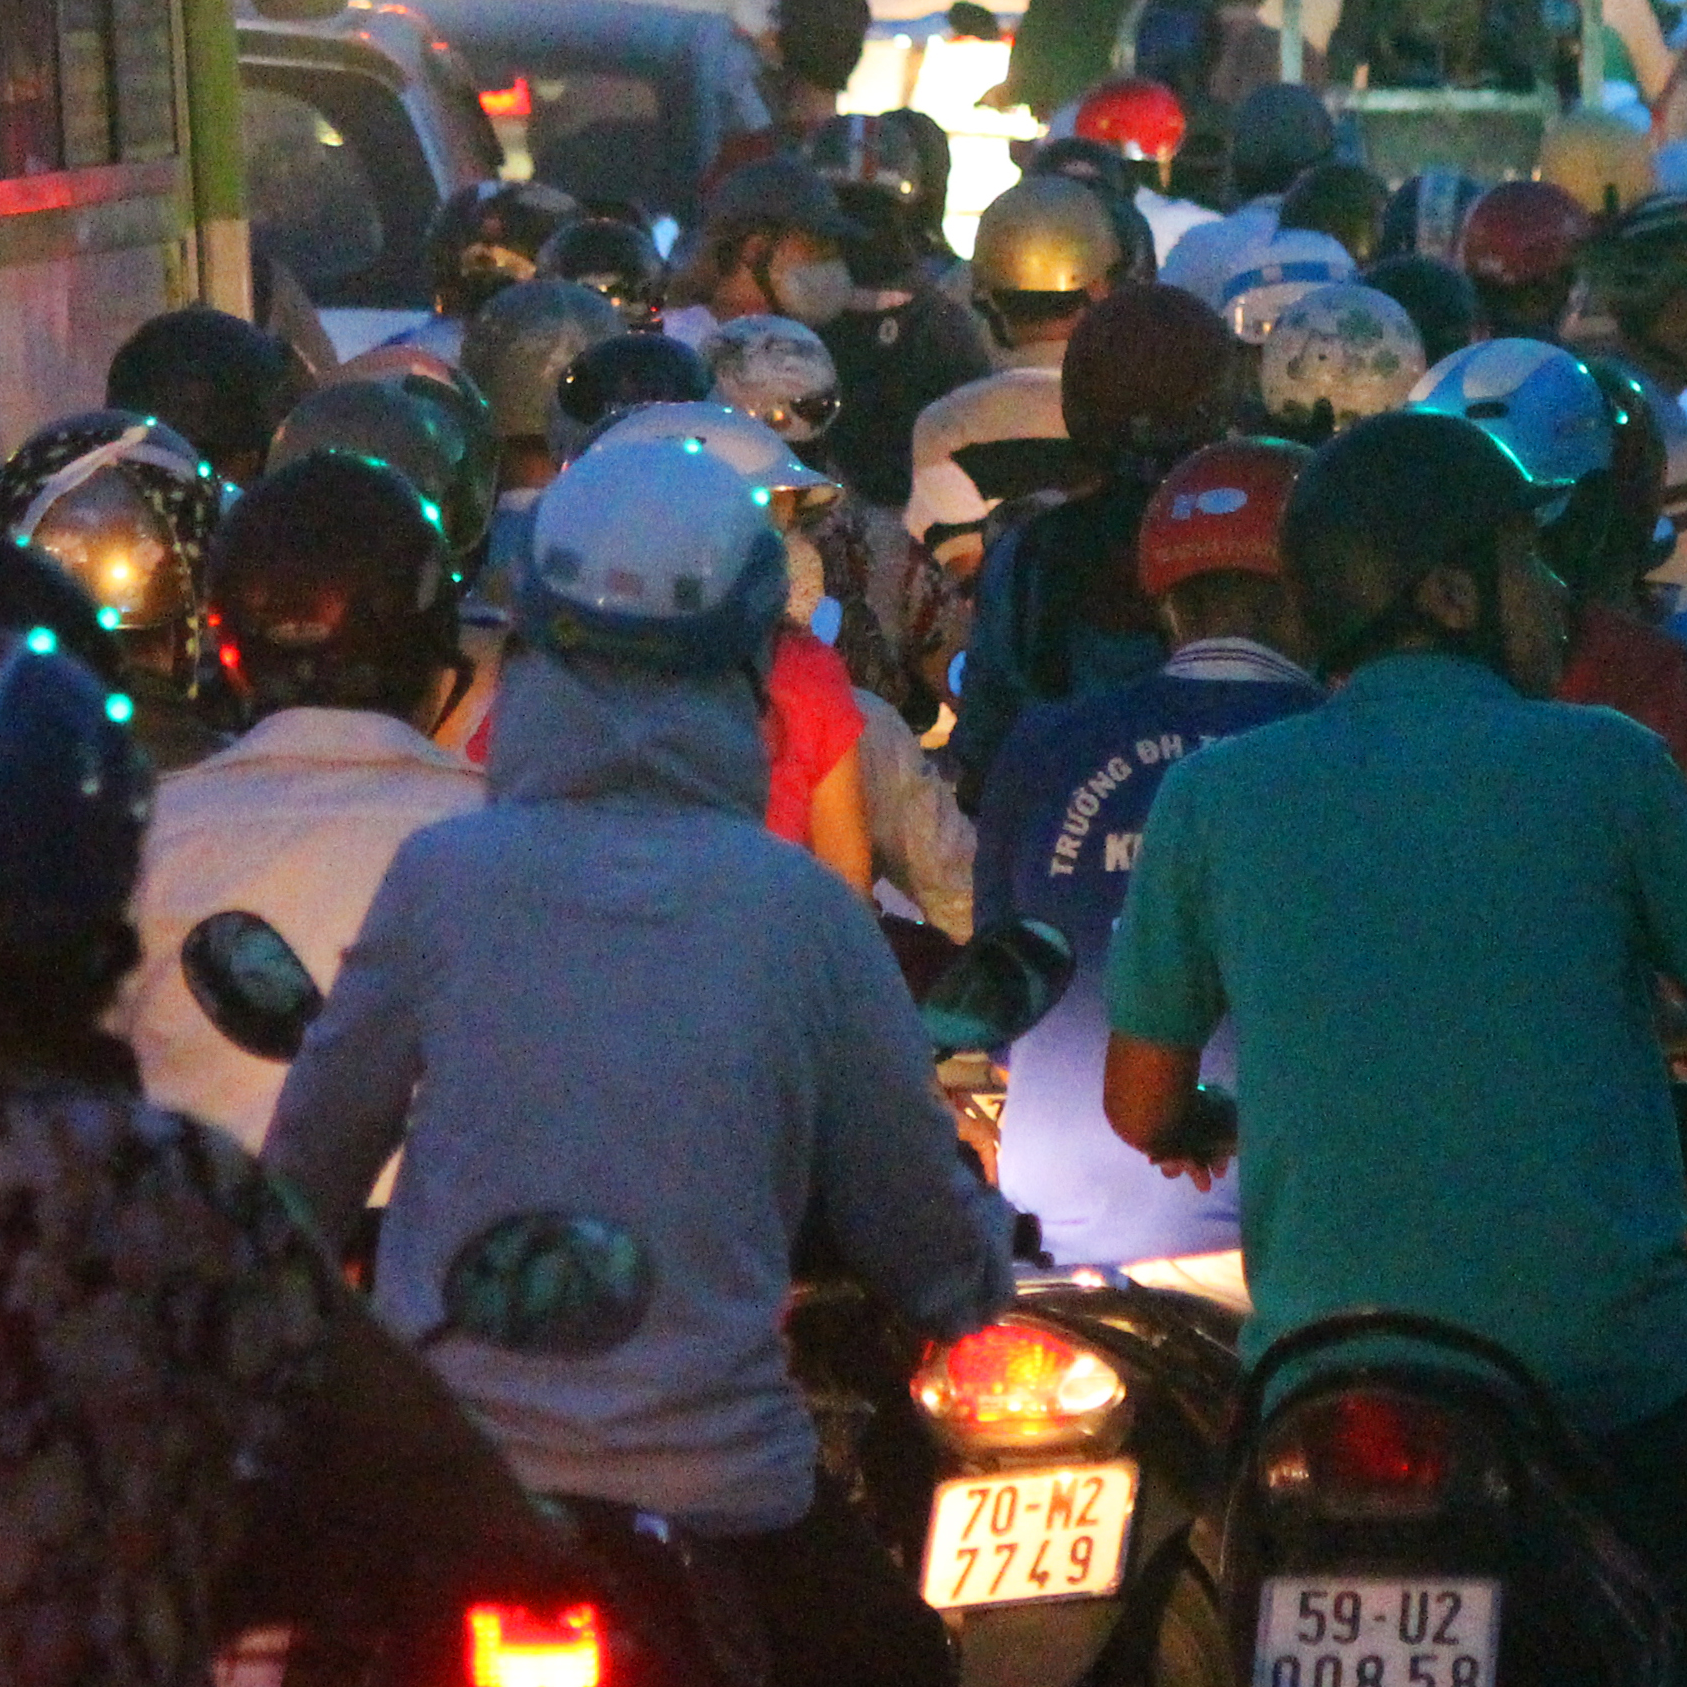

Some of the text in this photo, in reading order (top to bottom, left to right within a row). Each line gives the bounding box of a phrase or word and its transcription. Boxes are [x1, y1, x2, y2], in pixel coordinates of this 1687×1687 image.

[961, 1476, 1105, 1541] 70-M2
[950, 1534, 1094, 1601] 7749
[1298, 1589, 1463, 1646] 59-U2
